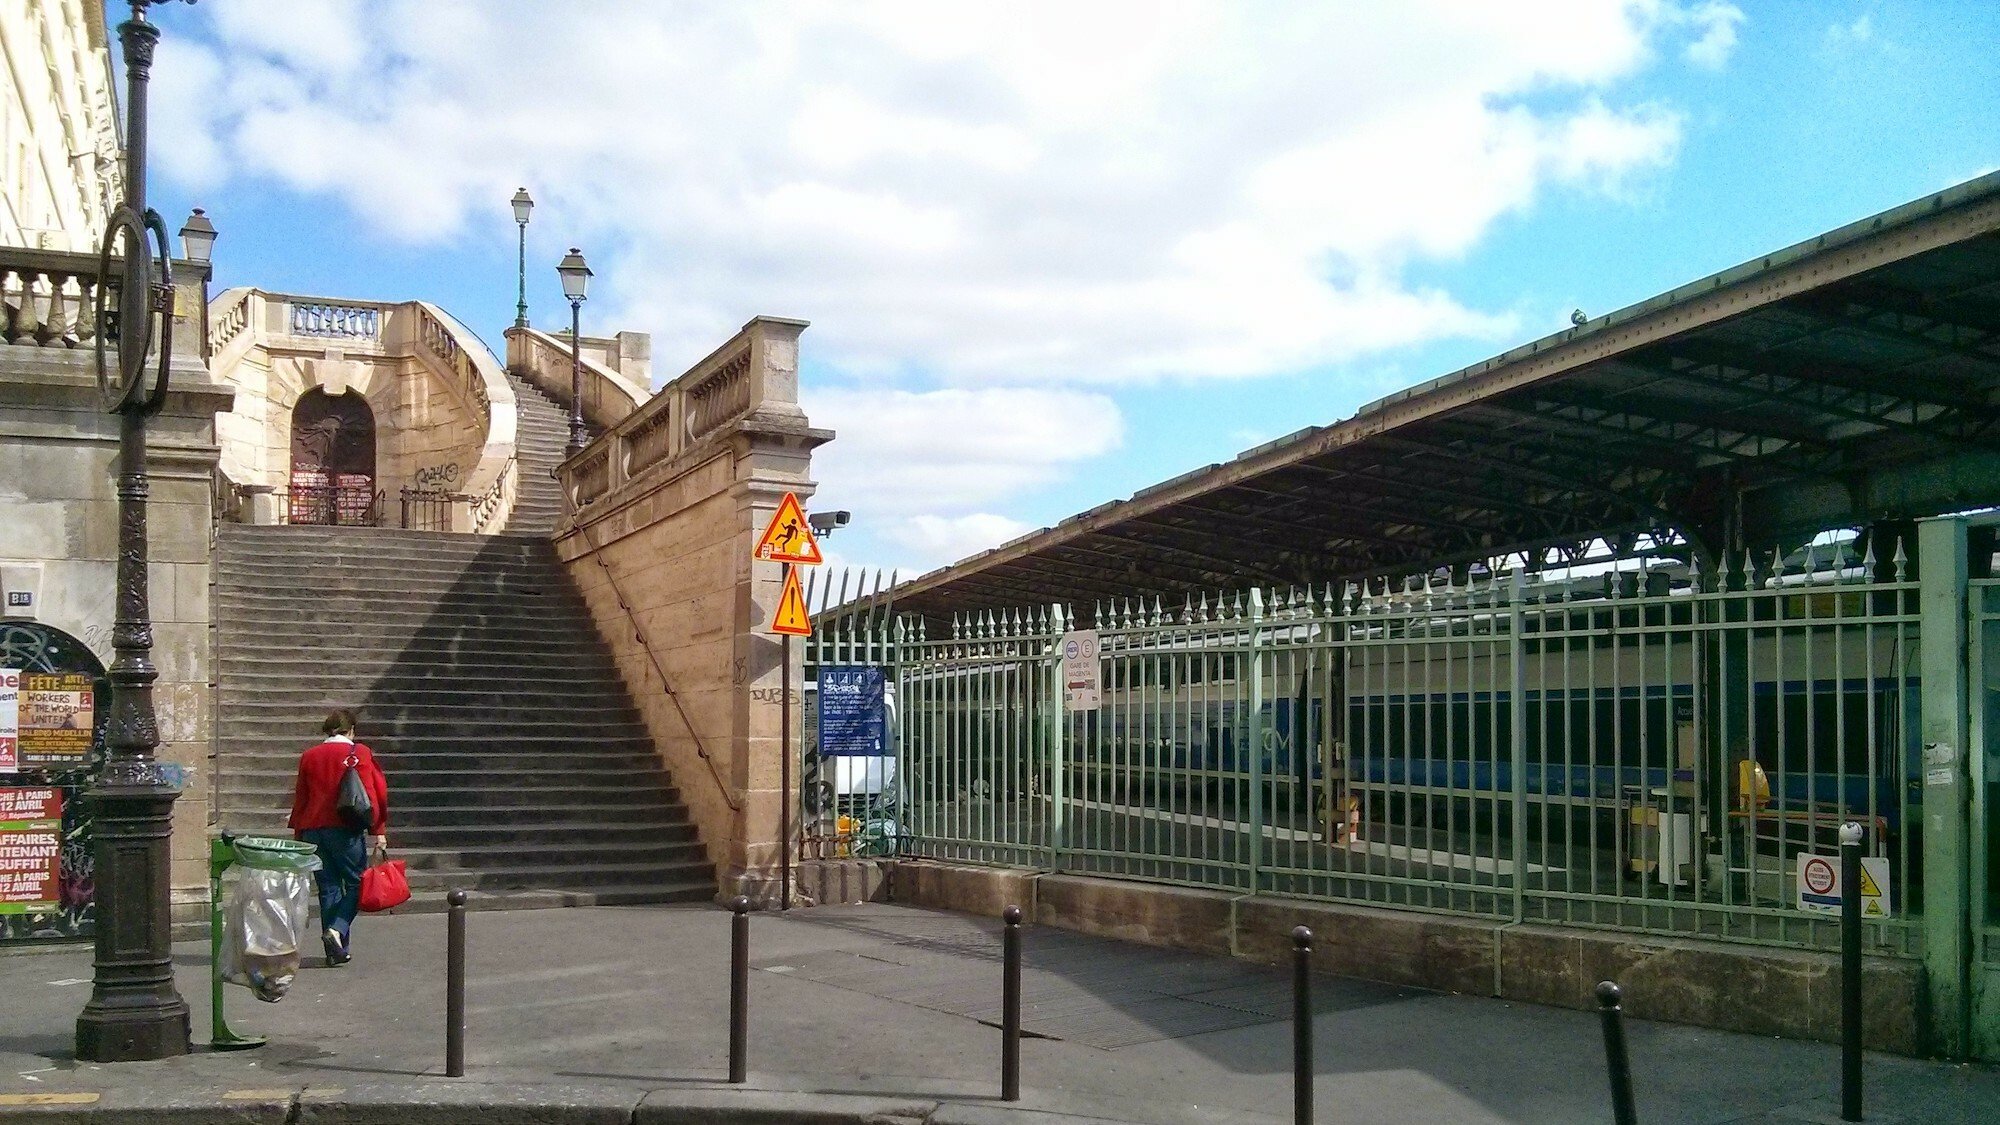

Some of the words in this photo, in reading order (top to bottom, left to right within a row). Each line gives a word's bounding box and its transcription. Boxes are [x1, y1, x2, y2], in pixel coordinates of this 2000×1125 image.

[29, 674, 60, 690] FÊTE
[0, 692, 18, 701] ent
[27, 692, 71, 704] WORKERS
[18, 704, 31, 713] OF
[34, 704, 50, 713] THE
[50, 704, 79, 715] WORLD
[17, 789, 24, 801] À
[25, 790, 53, 800] PARIS
[15, 800, 45, 811] AVRIL
[14, 871, 21, 882] À
[23, 872, 50, 881] PARIS
[12, 881, 43, 892] AVRIL
